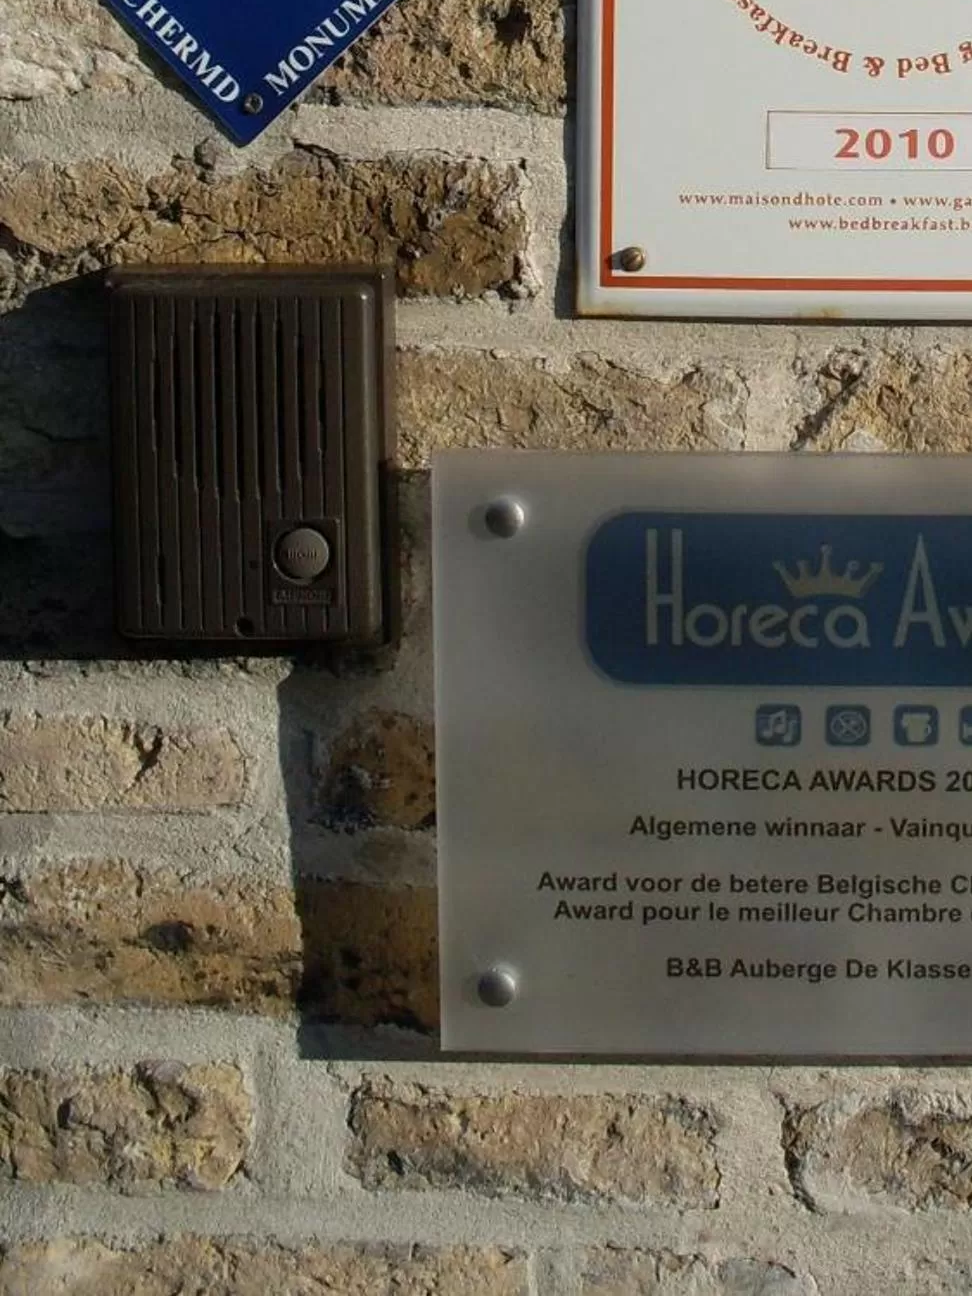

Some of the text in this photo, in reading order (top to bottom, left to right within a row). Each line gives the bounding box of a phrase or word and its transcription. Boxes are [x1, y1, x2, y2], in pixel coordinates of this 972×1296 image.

[863, 56, 885, 77] &
[897, 53, 951, 78] Bed
[834, 128, 955, 159] 2010
[678, 191, 883, 207] www.maisondhote.com
[645, 528, 871, 648] Horeca
[676, 768, 802, 792] HORECA
[809, 769, 937, 793] AWARDS
[629, 815, 757, 840] Algemene
[765, 817, 867, 837] winnaar
[537, 871, 617, 892] Award
[626, 876, 682, 894] voor
[691, 873, 721, 894] de
[730, 873, 809, 894] betere
[817, 874, 942, 899] Belgische
[553, 899, 633, 920] Award
[642, 903, 700, 925] pour
[708, 901, 730, 922] le
[738, 901, 840, 922] meilleur
[848, 901, 962, 923] Chambre
[666, 956, 722, 979] B&B
[729, 957, 837, 983] Auberge
[845, 958, 879, 979] De
[887, 958, 972, 979] Klasse
